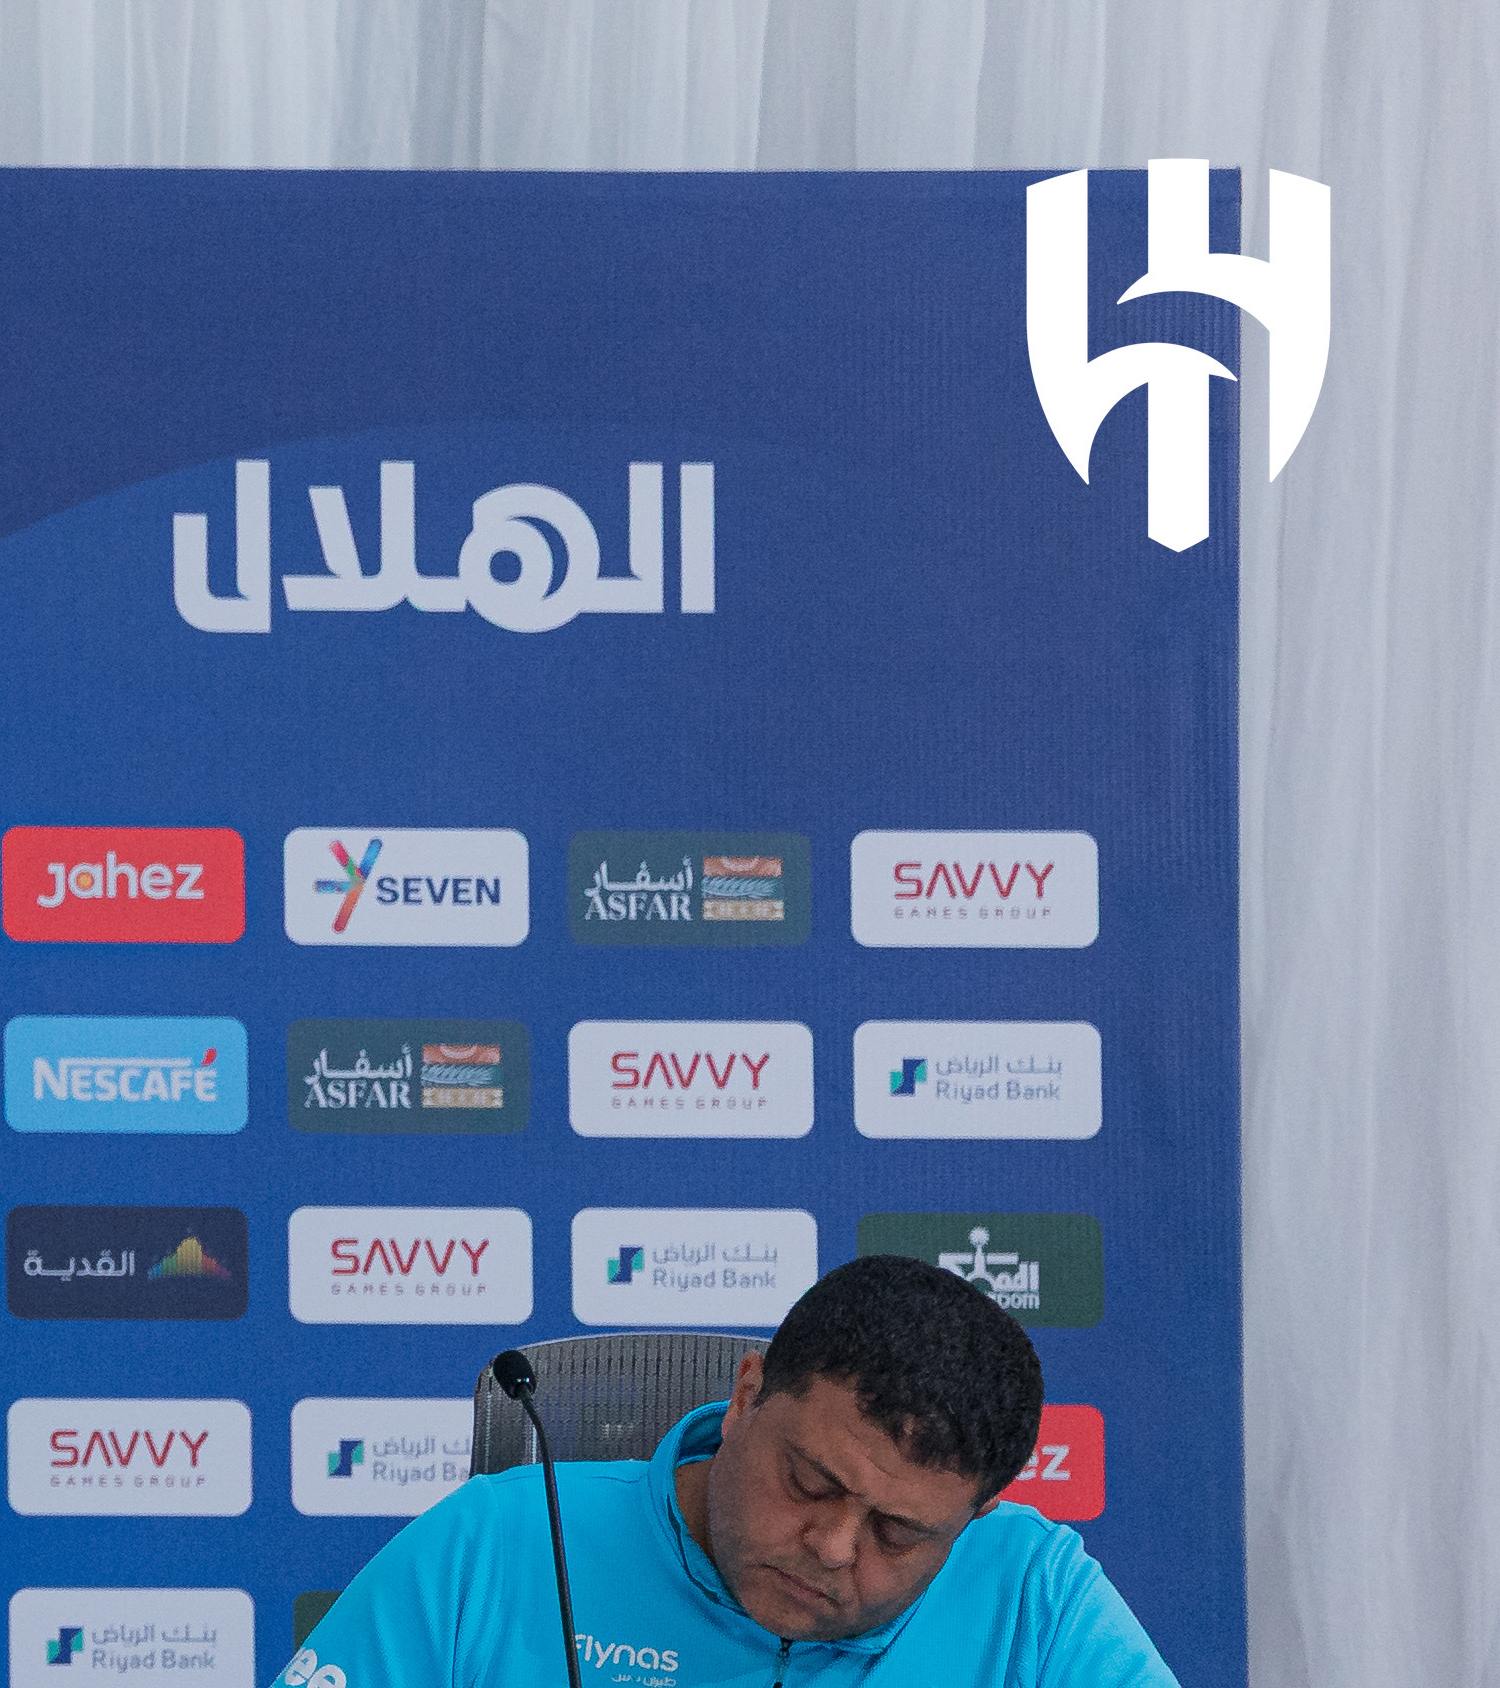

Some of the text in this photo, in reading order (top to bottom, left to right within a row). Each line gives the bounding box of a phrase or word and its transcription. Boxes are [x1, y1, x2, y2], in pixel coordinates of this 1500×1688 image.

[173, 459, 716, 634] الهلال
[377, 876, 501, 906] SEVEN
[892, 861, 1054, 900] SAVVY
[584, 894, 691, 921] ASFAR
[33, 1048, 218, 1102] NESCAFÉ
[610, 1051, 770, 1090] SAVVY
[304, 1081, 410, 1109] ASFAR
[936, 1082, 1060, 1105] Riyad Bank
[24, 1251, 136, 1280] القدية
[330, 1238, 490, 1277] SAVVY
[653, 1270, 776, 1292] Riyad Bank
[49, 1429, 209, 1468] SAVVY
[372, 1461, 437, 1486] Riyad
[92, 1651, 215, 1674] Riyad Bank
